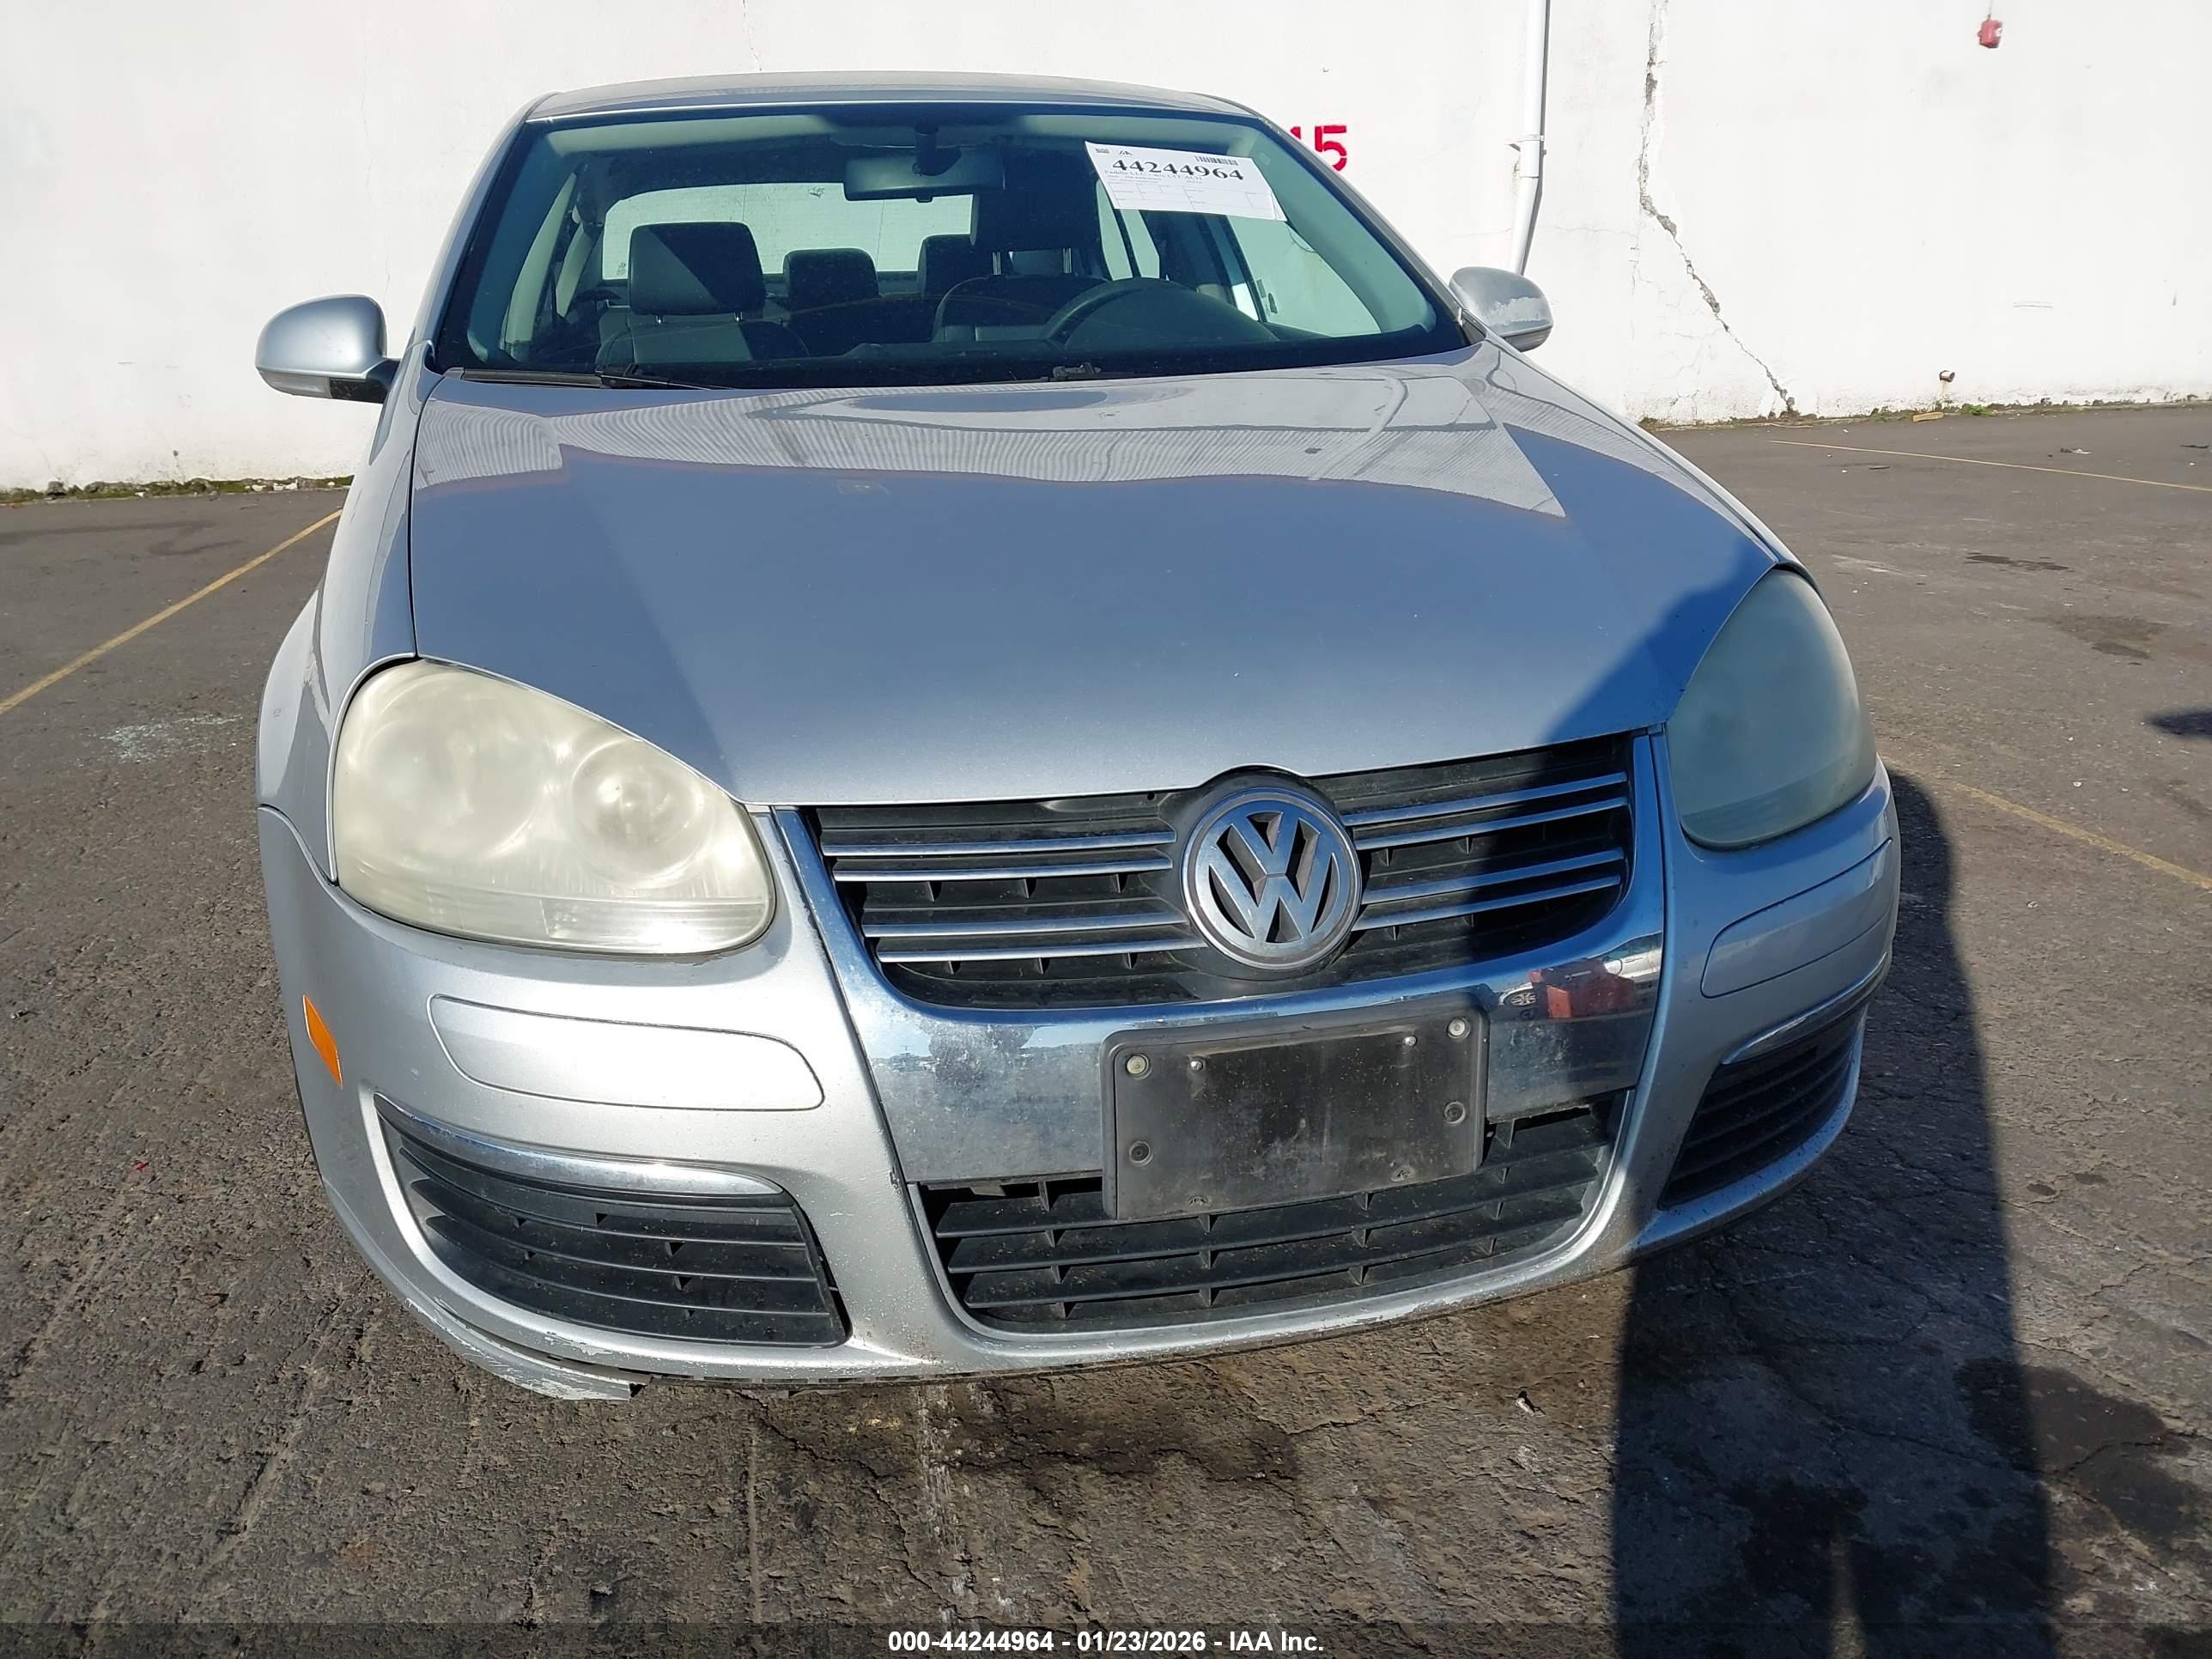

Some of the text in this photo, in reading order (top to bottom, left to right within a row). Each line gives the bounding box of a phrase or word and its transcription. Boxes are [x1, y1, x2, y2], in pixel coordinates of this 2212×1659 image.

[1112, 159, 1244, 181] 44244964
[1290, 124, 1347, 172] 5
[1195, 799, 1350, 958] VW
